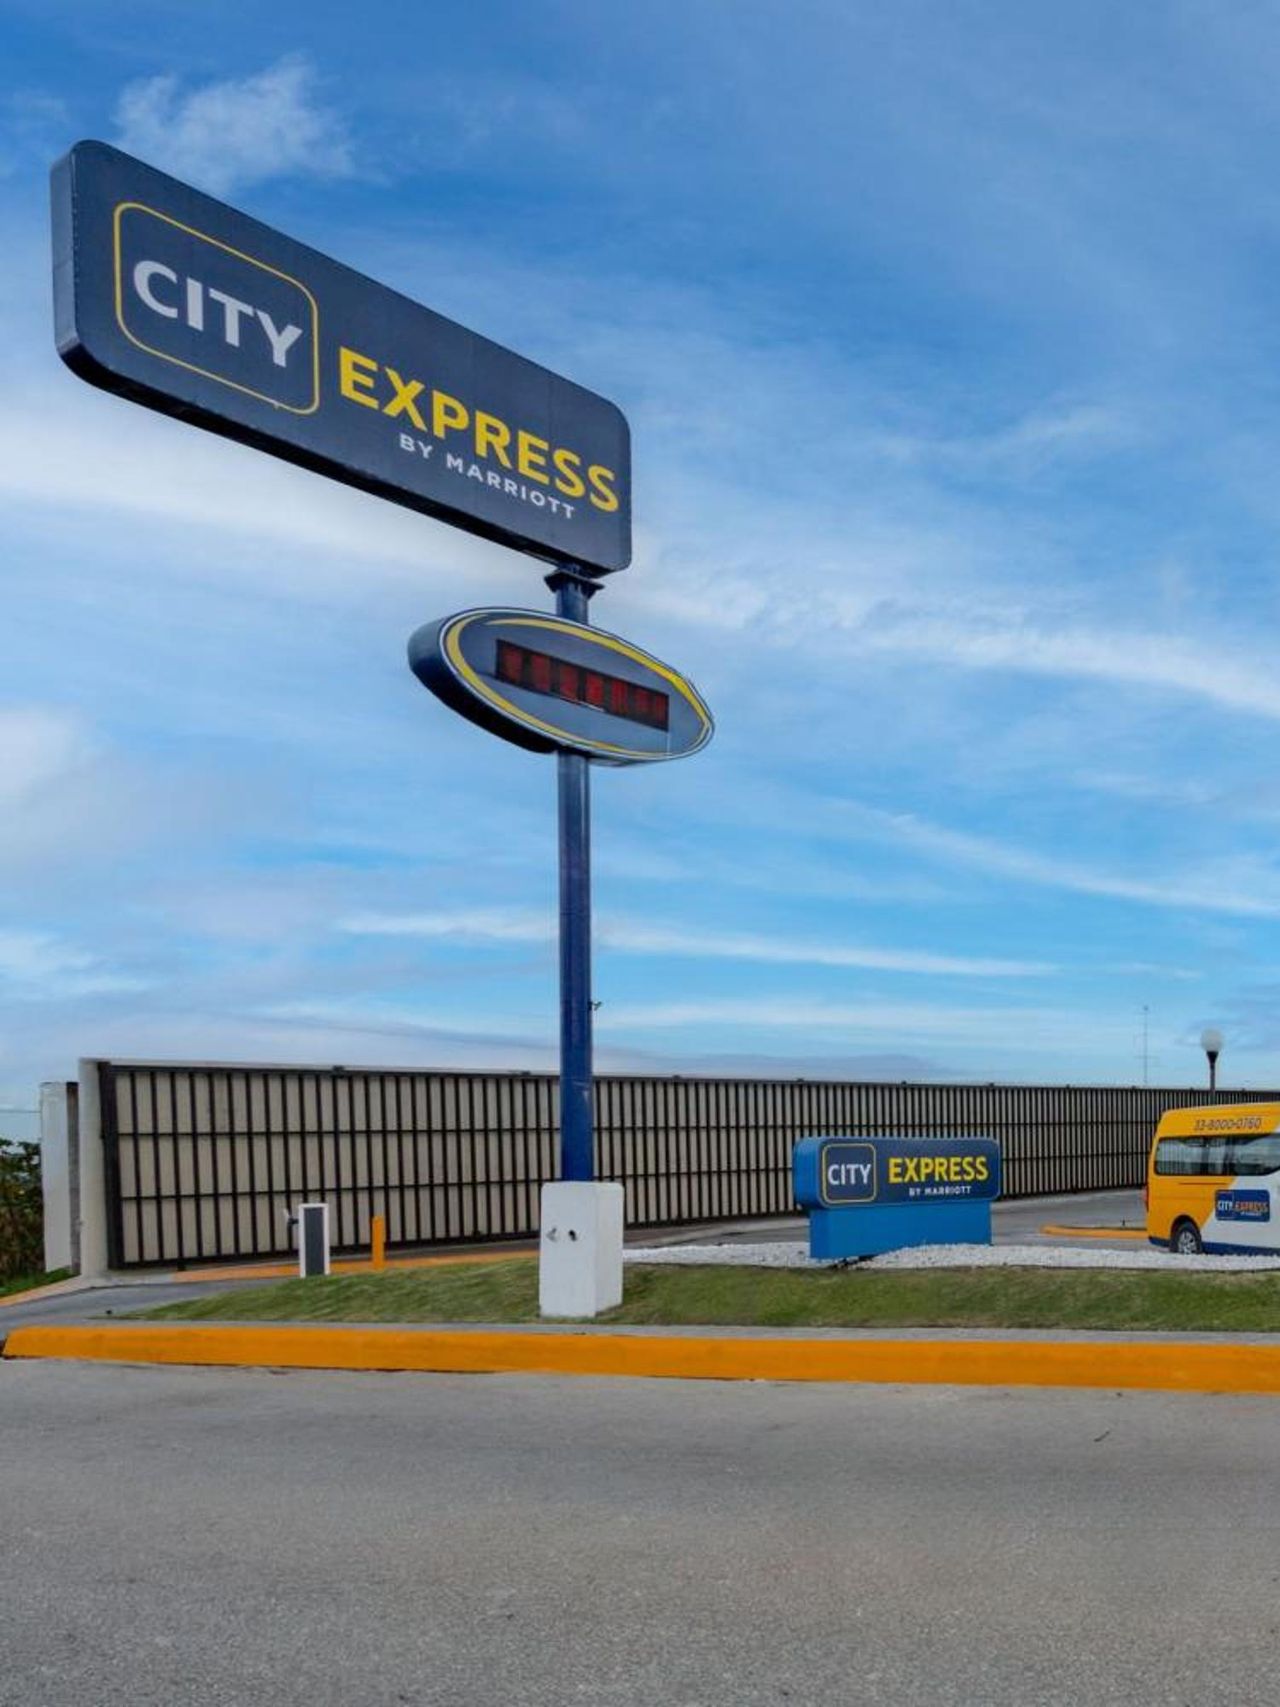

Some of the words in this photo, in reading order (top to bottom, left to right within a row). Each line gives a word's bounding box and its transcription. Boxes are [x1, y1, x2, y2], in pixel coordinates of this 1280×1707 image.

[132, 260, 304, 368] CITY
[339, 346, 619, 513] EXPRESS
[399, 432, 434, 460] BY
[446, 453, 576, 519] MARRIOTT
[827, 1163, 872, 1186] CITY
[888, 1155, 989, 1184] EXPRESS
[909, 1187, 921, 1196] BY
[924, 1186, 972, 1196] MARRIOTT
